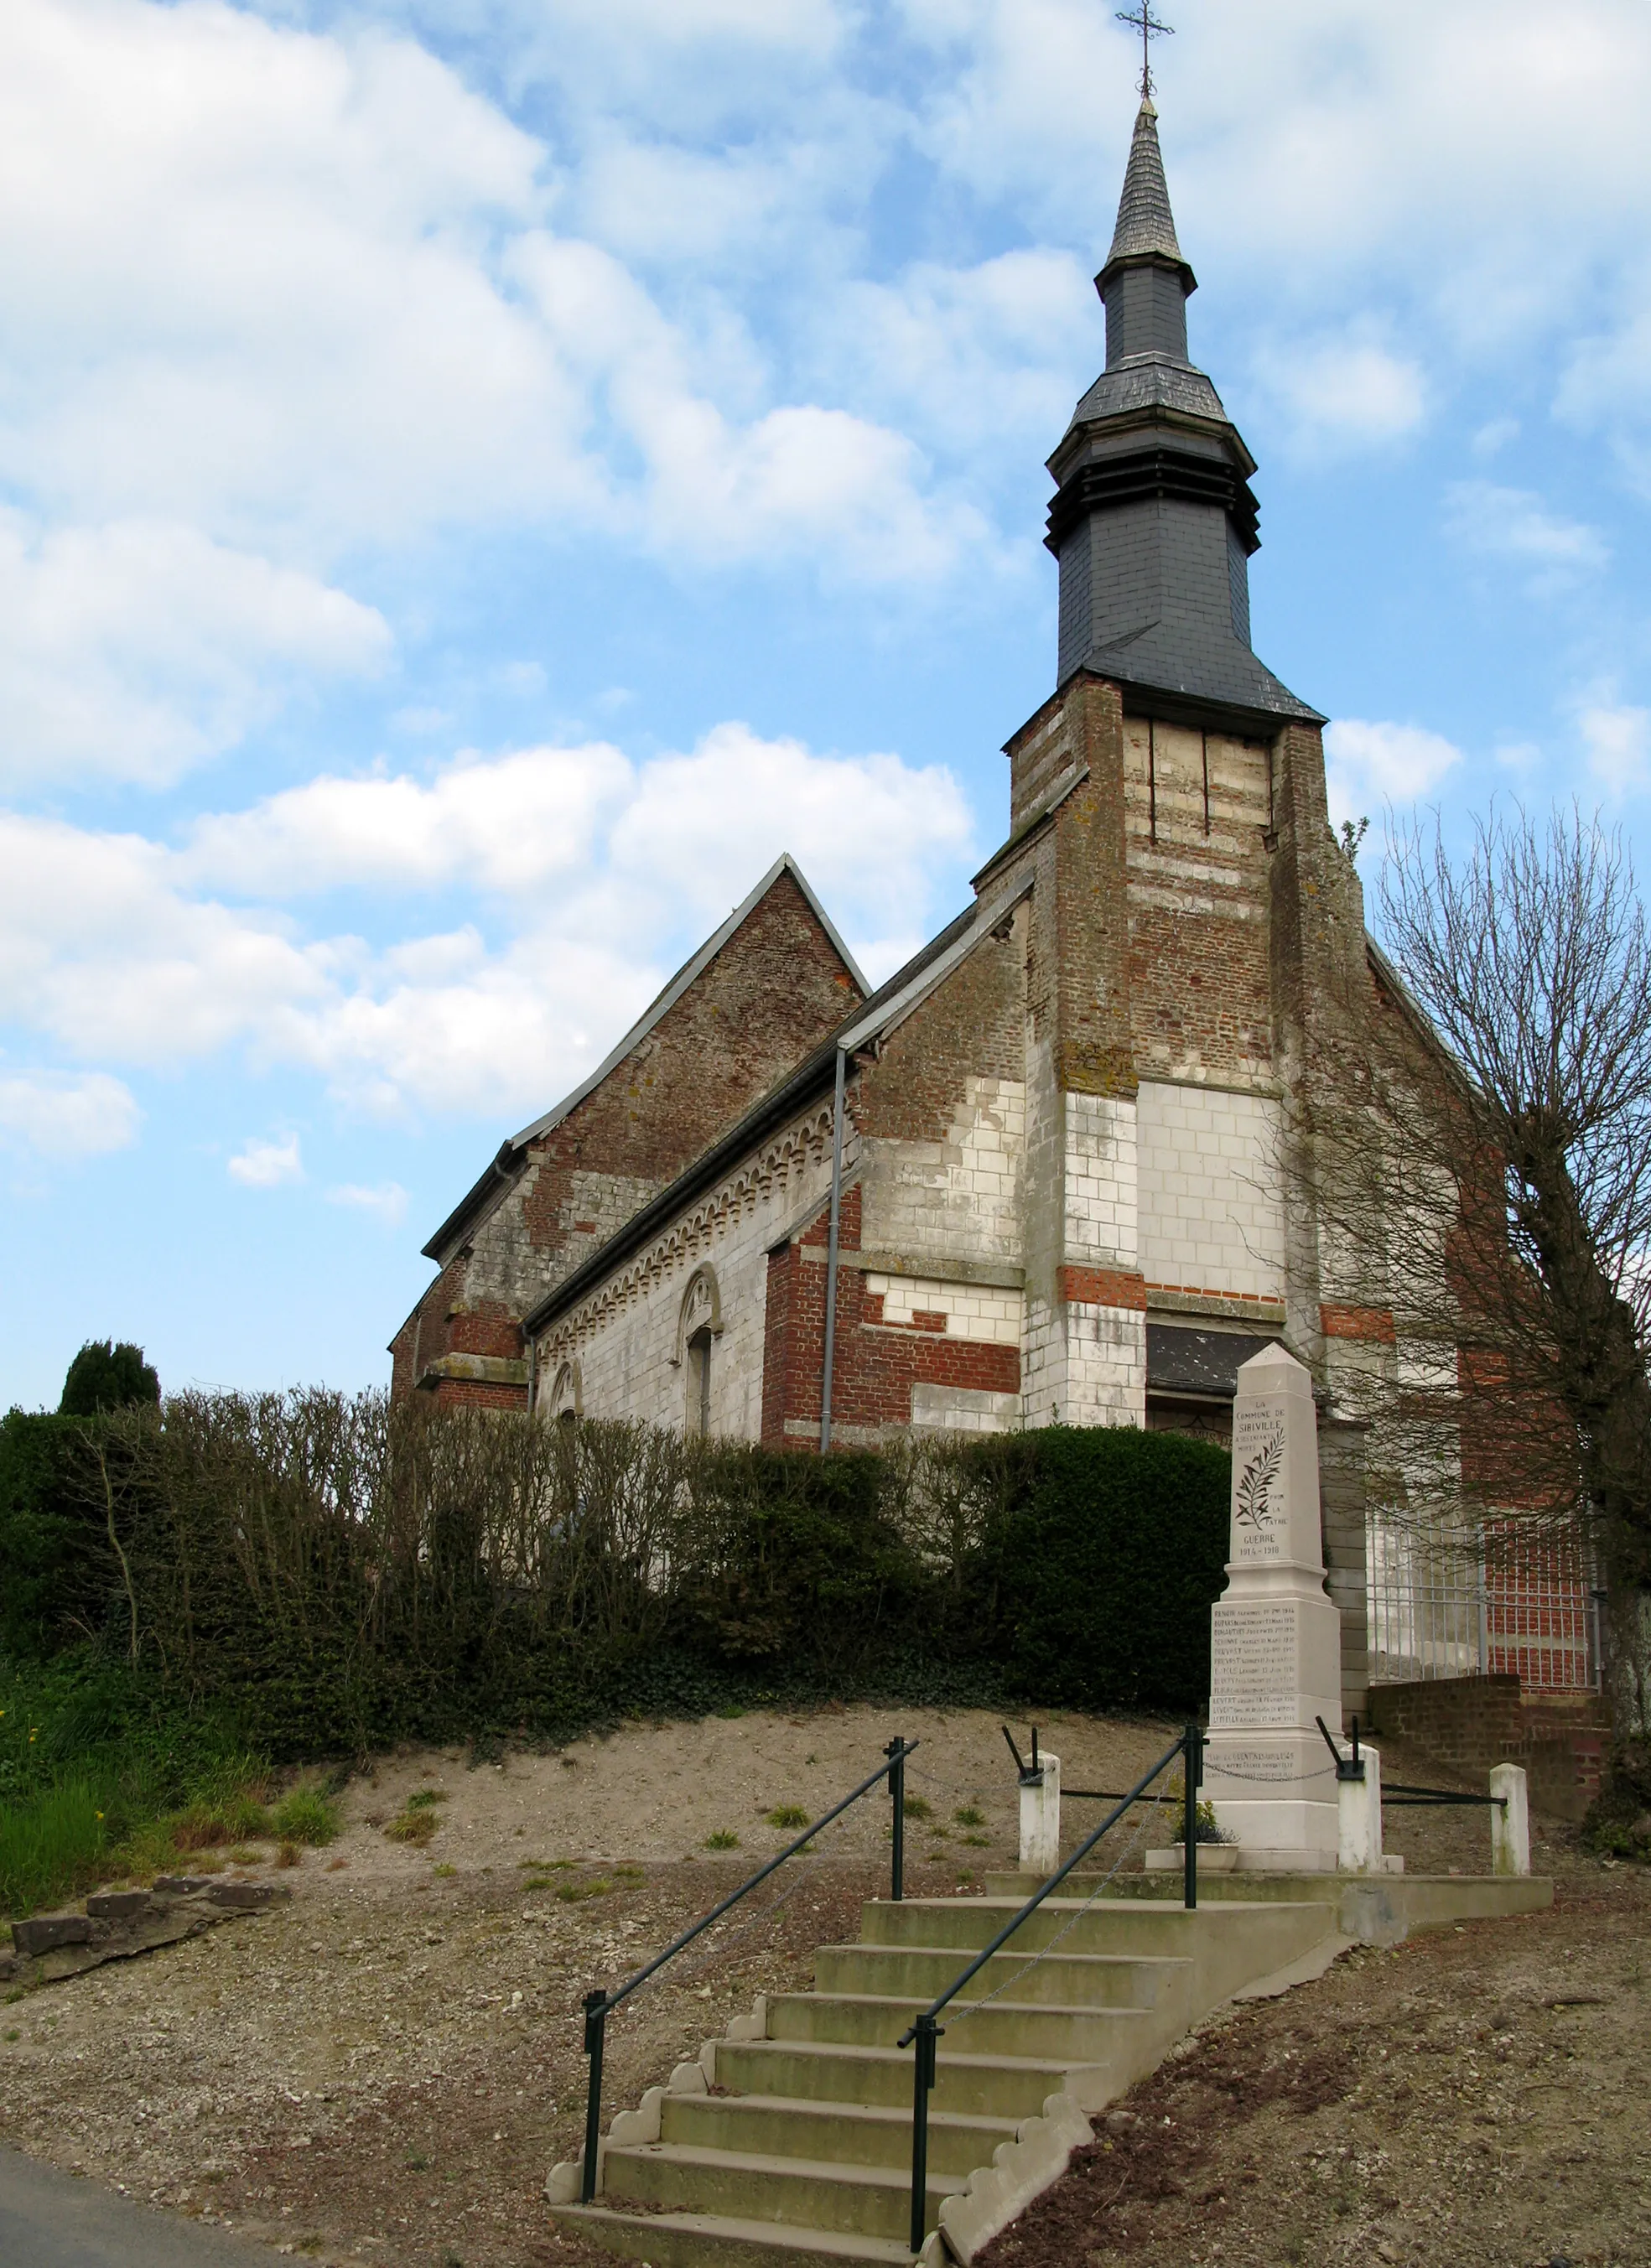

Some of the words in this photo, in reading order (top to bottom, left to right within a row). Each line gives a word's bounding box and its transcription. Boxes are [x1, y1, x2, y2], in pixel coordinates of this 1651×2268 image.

[1236, 1410, 1270, 1420] COMMUNE
[1275, 1409, 1285, 1417] DE
[1238, 1419, 1281, 1433] SIBIVILLE
[1243, 1534, 1275, 1544] GUERRE
